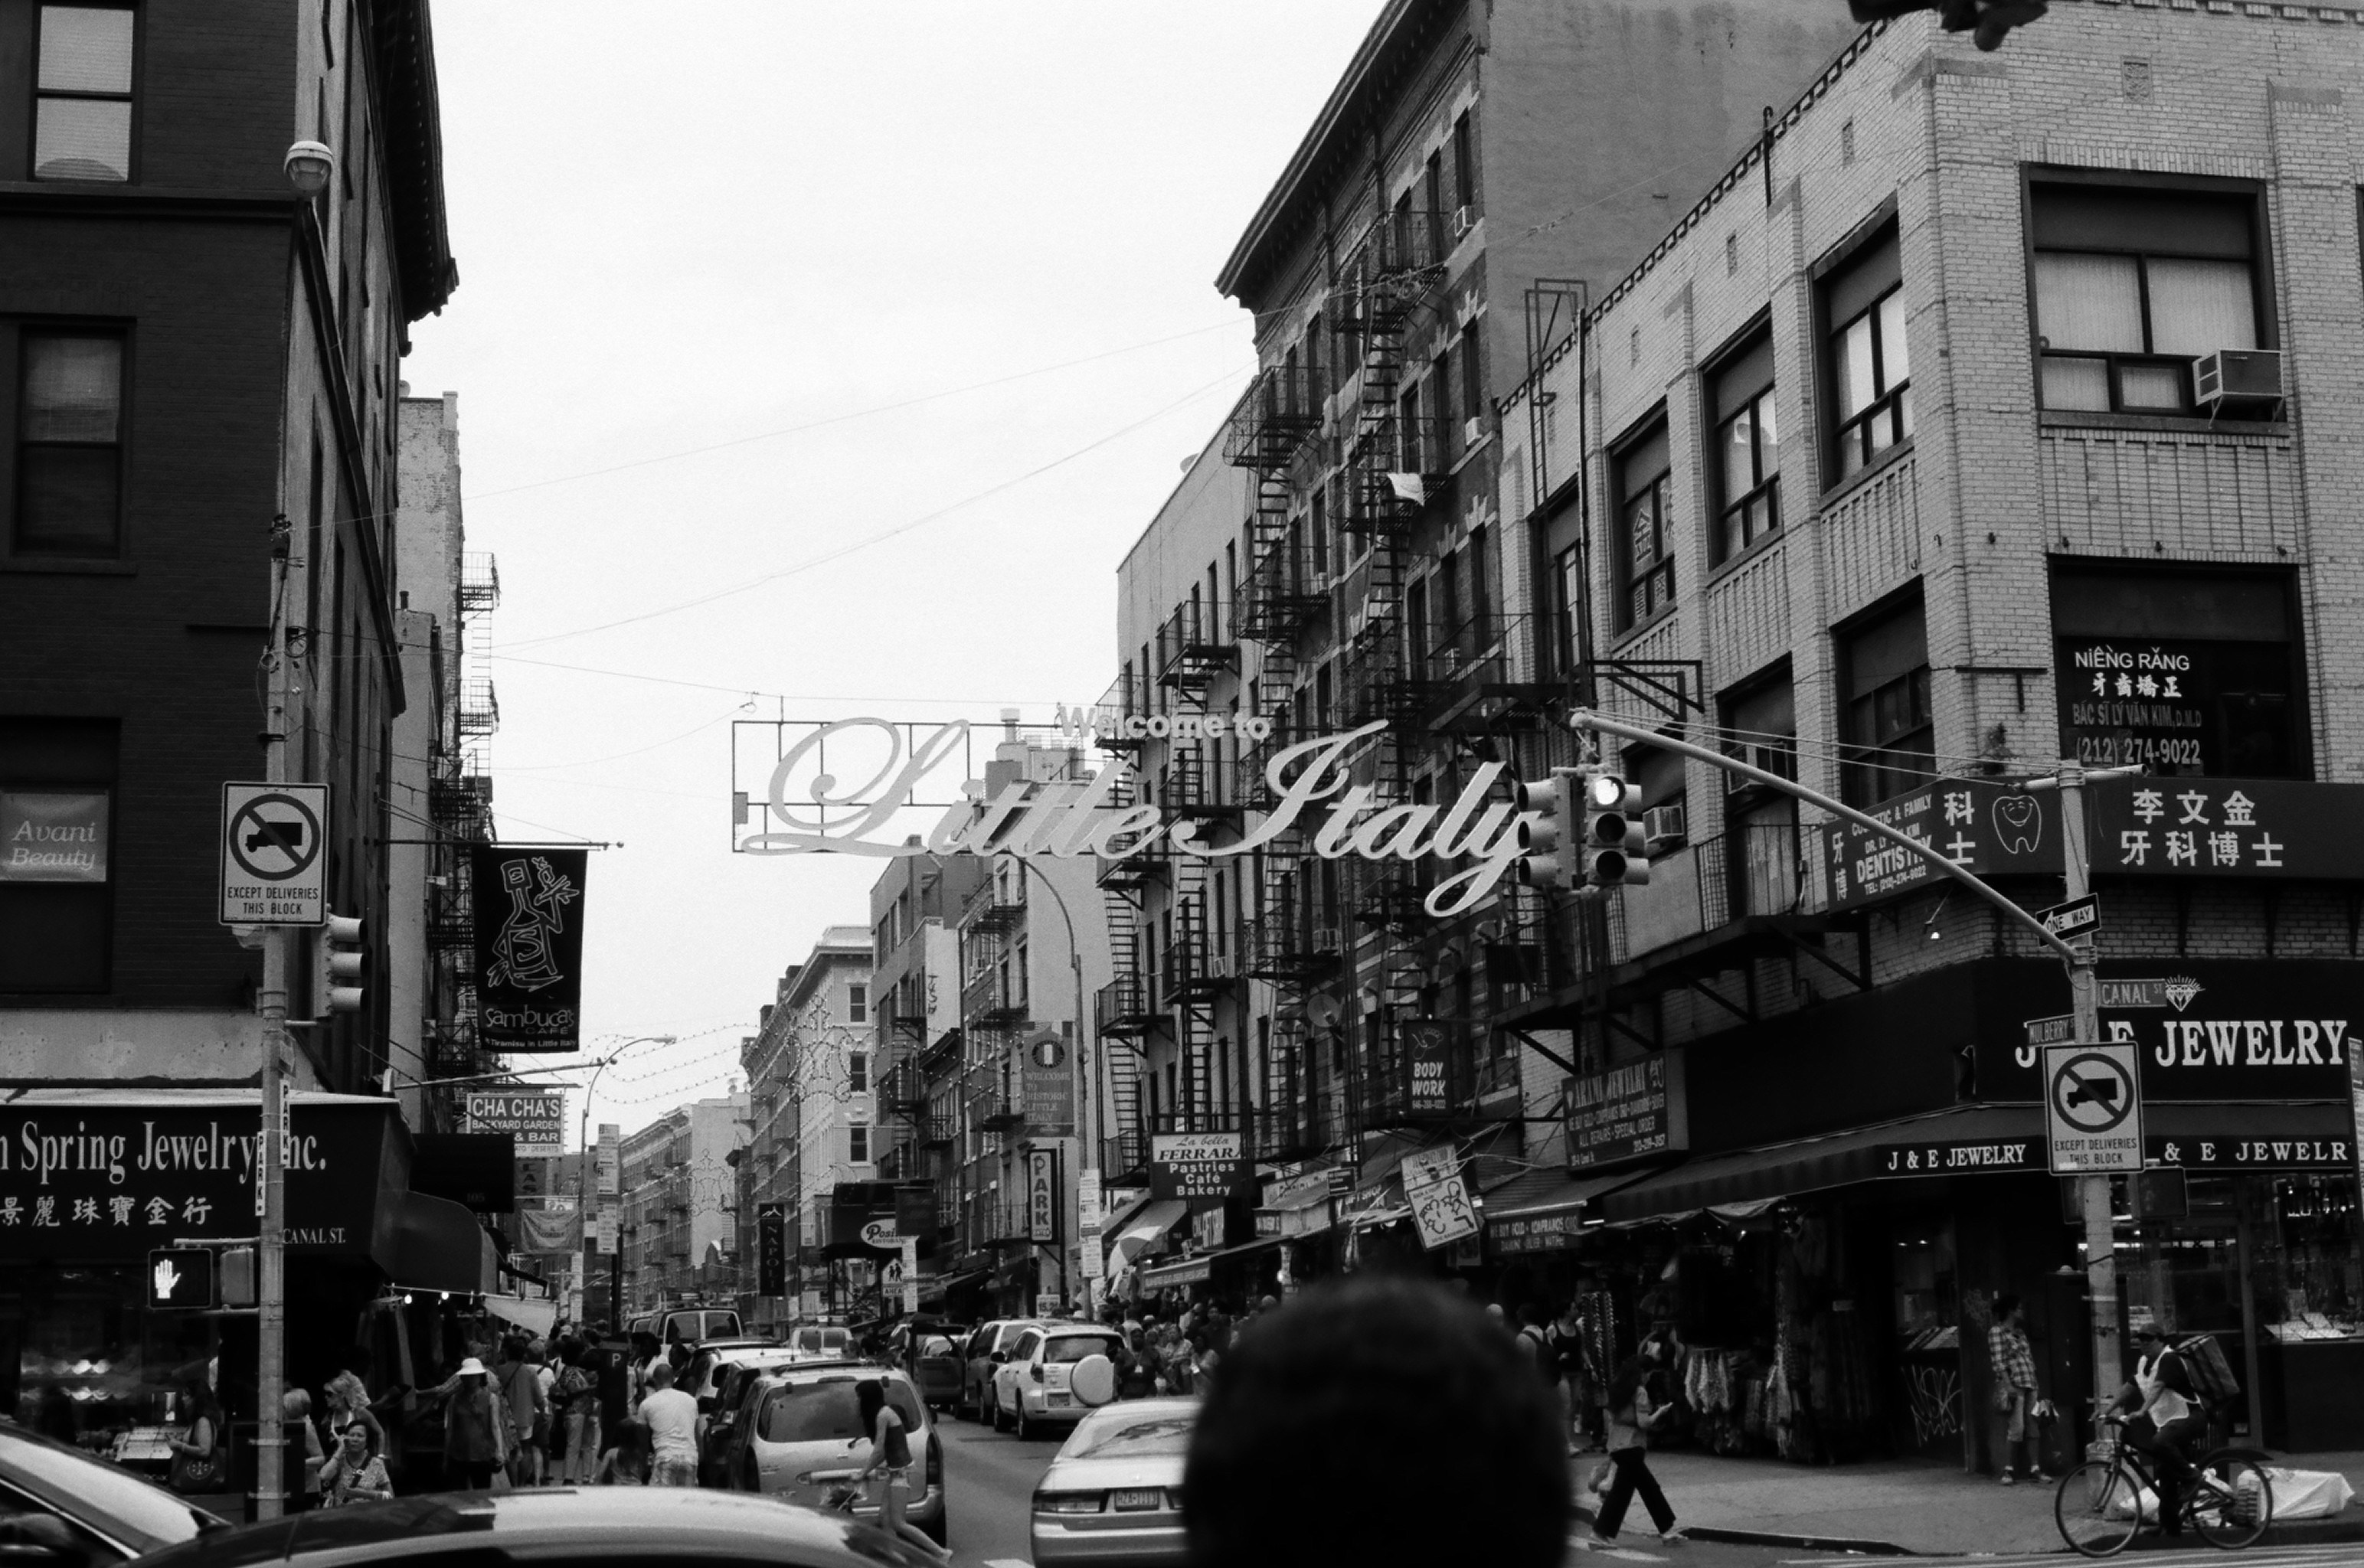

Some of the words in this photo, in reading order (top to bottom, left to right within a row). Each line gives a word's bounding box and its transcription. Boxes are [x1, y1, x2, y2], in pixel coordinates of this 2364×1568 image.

[1059, 704, 1225, 738] Welcome
[1232, 711, 1271, 739] to
[2076, 737, 2118, 766] (212)
[2124, 737, 2202, 765] 274-9022
[1904, 794, 1932, 818] FAMILY
[2133, 788, 2257, 826] 李文金
[741, 718, 1164, 858] Little
[1169, 718, 1532, 917] Italy
[11, 820, 96, 843] Avani
[2120, 830, 2284, 867] 牙科博士
[11, 847, 96, 871] Beauty
[227, 887, 261, 899] EXCEPT
[266, 887, 319, 900] DELIVERIES
[244, 903, 264, 914] THIS
[271, 903, 302, 915] BLOCK
[2046, 916, 2065, 932] ONE
[2071, 906, 2091, 925] WAY
[2101, 983, 2150, 1005] CANAL
[2153, 983, 2164, 995] ST
[2155, 1020, 2348, 1068] JEWELRY
[1026, 1072, 1071, 1081] WELCOME
[1414, 1061, 1444, 1078] BODY
[1411, 1080, 1447, 1096] WORK
[472, 1098, 507, 1117] CHA
[512, 1098, 560, 1118] CHA'S
[472, 1119, 522, 1129] BACKYARD
[523, 1119, 560, 1129] GARDEN
[514, 1132, 524, 1142] &
[528, 1132, 558, 1142] BAR
[1201, 1135, 1228, 1147] bella
[2055, 1139, 2084, 1152] EXCEPT
[2088, 1138, 2138, 1150] DELIVERIES
[21, 1120, 126, 1185] Spring
[137, 1121, 257, 1184] Jewelry
[1159, 1147, 1241, 1161] FERRAR
[1888, 1151, 1898, 1171] J
[1907, 1150, 1919, 1169] &
[1927, 1149, 1939, 1168] E
[1946, 1144, 2027, 1168] JEWELRY
[2070, 1154, 2088, 1165] THIS
[2094, 1153, 2124, 1164] BLOCK
[2164, 1142, 2181, 1161] &
[2200, 1142, 2216, 1160] E
[2235, 1142, 2351, 1161] JEWELR
[1169, 1161, 1236, 1174] Pastries
[1185, 1171, 1221, 1184] Café
[467, 1192, 486, 1203] 105
[1033, 1155, 1048, 1225] PARK
[1176, 1184, 1231, 1197] Bakery
[0, 1194, 213, 1227] 景麗珠寶金行
[283, 1227, 327, 1244] CANAL
[329, 1227, 347, 1243] ST.
[884, 1286, 902, 1295] AHEA
